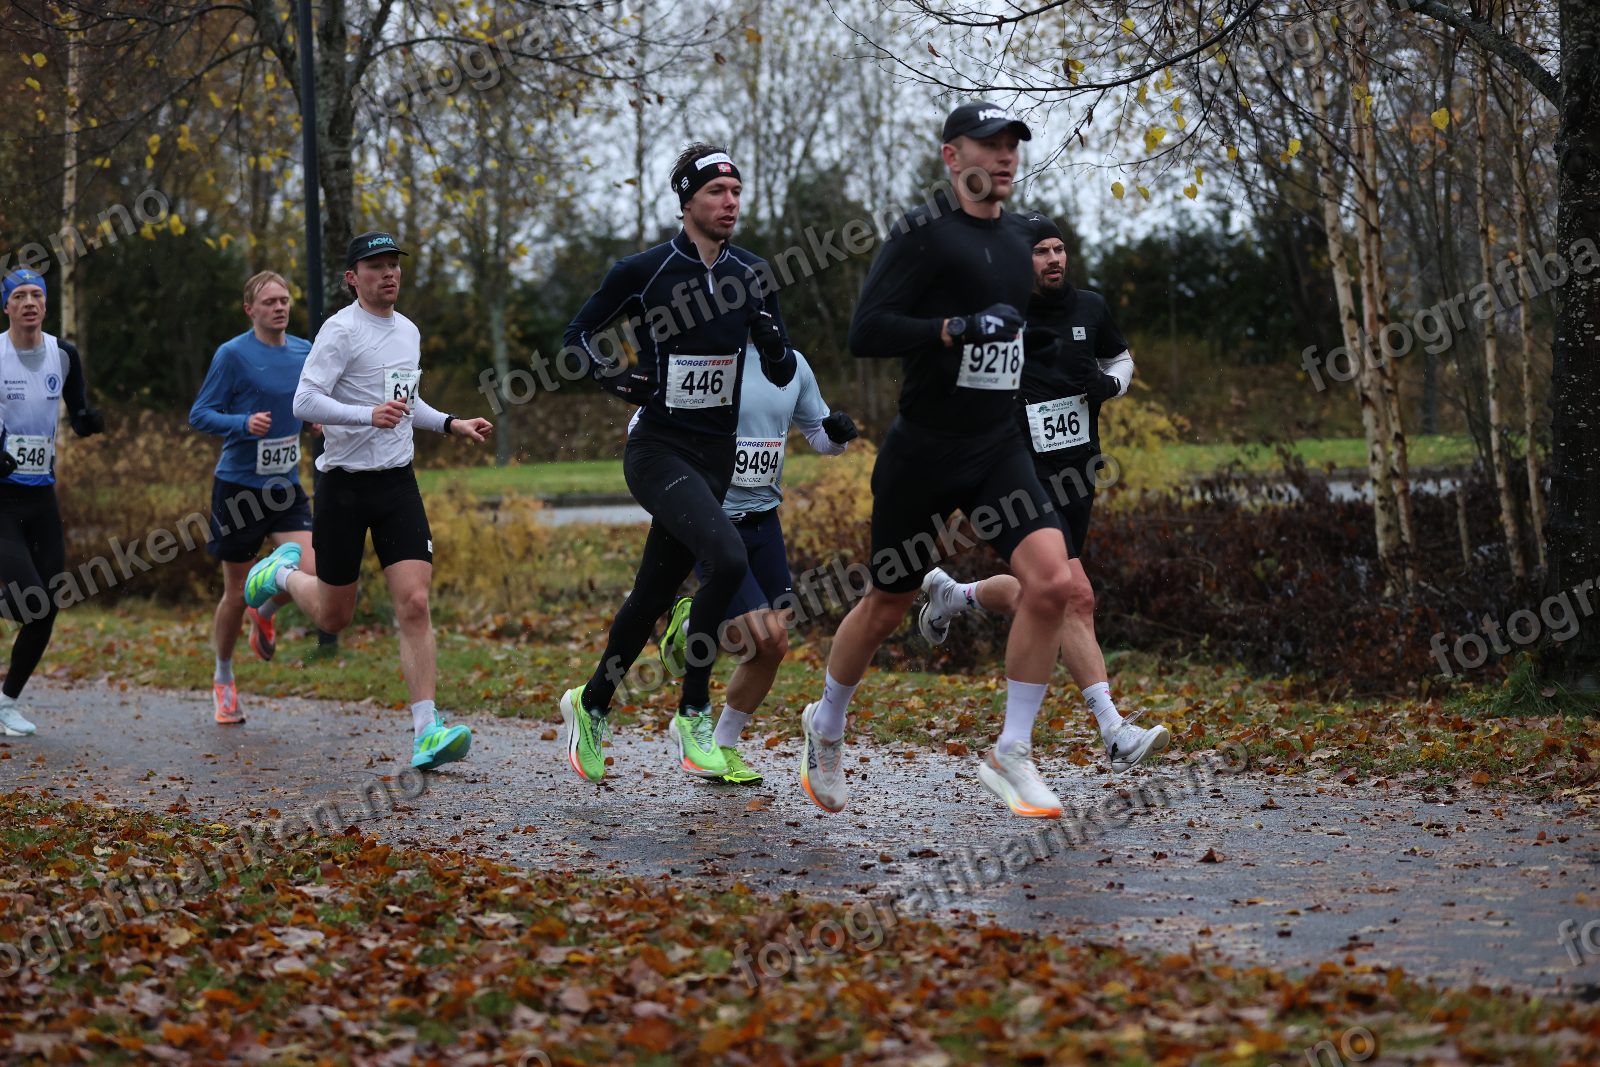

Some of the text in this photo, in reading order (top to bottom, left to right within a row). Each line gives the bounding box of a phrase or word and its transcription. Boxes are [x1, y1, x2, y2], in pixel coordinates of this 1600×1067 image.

[979, 109, 1008, 121] HO
[368, 237, 396, 249] HOKA
[674, 359, 733, 367] NORGESTESTEN
[969, 344, 1019, 374] 9218
[681, 370, 723, 395] 446
[1043, 411, 1080, 440] 546
[17, 447, 45, 467] 548
[262, 444, 297, 466] 9478
[736, 450, 779, 474] 9494
